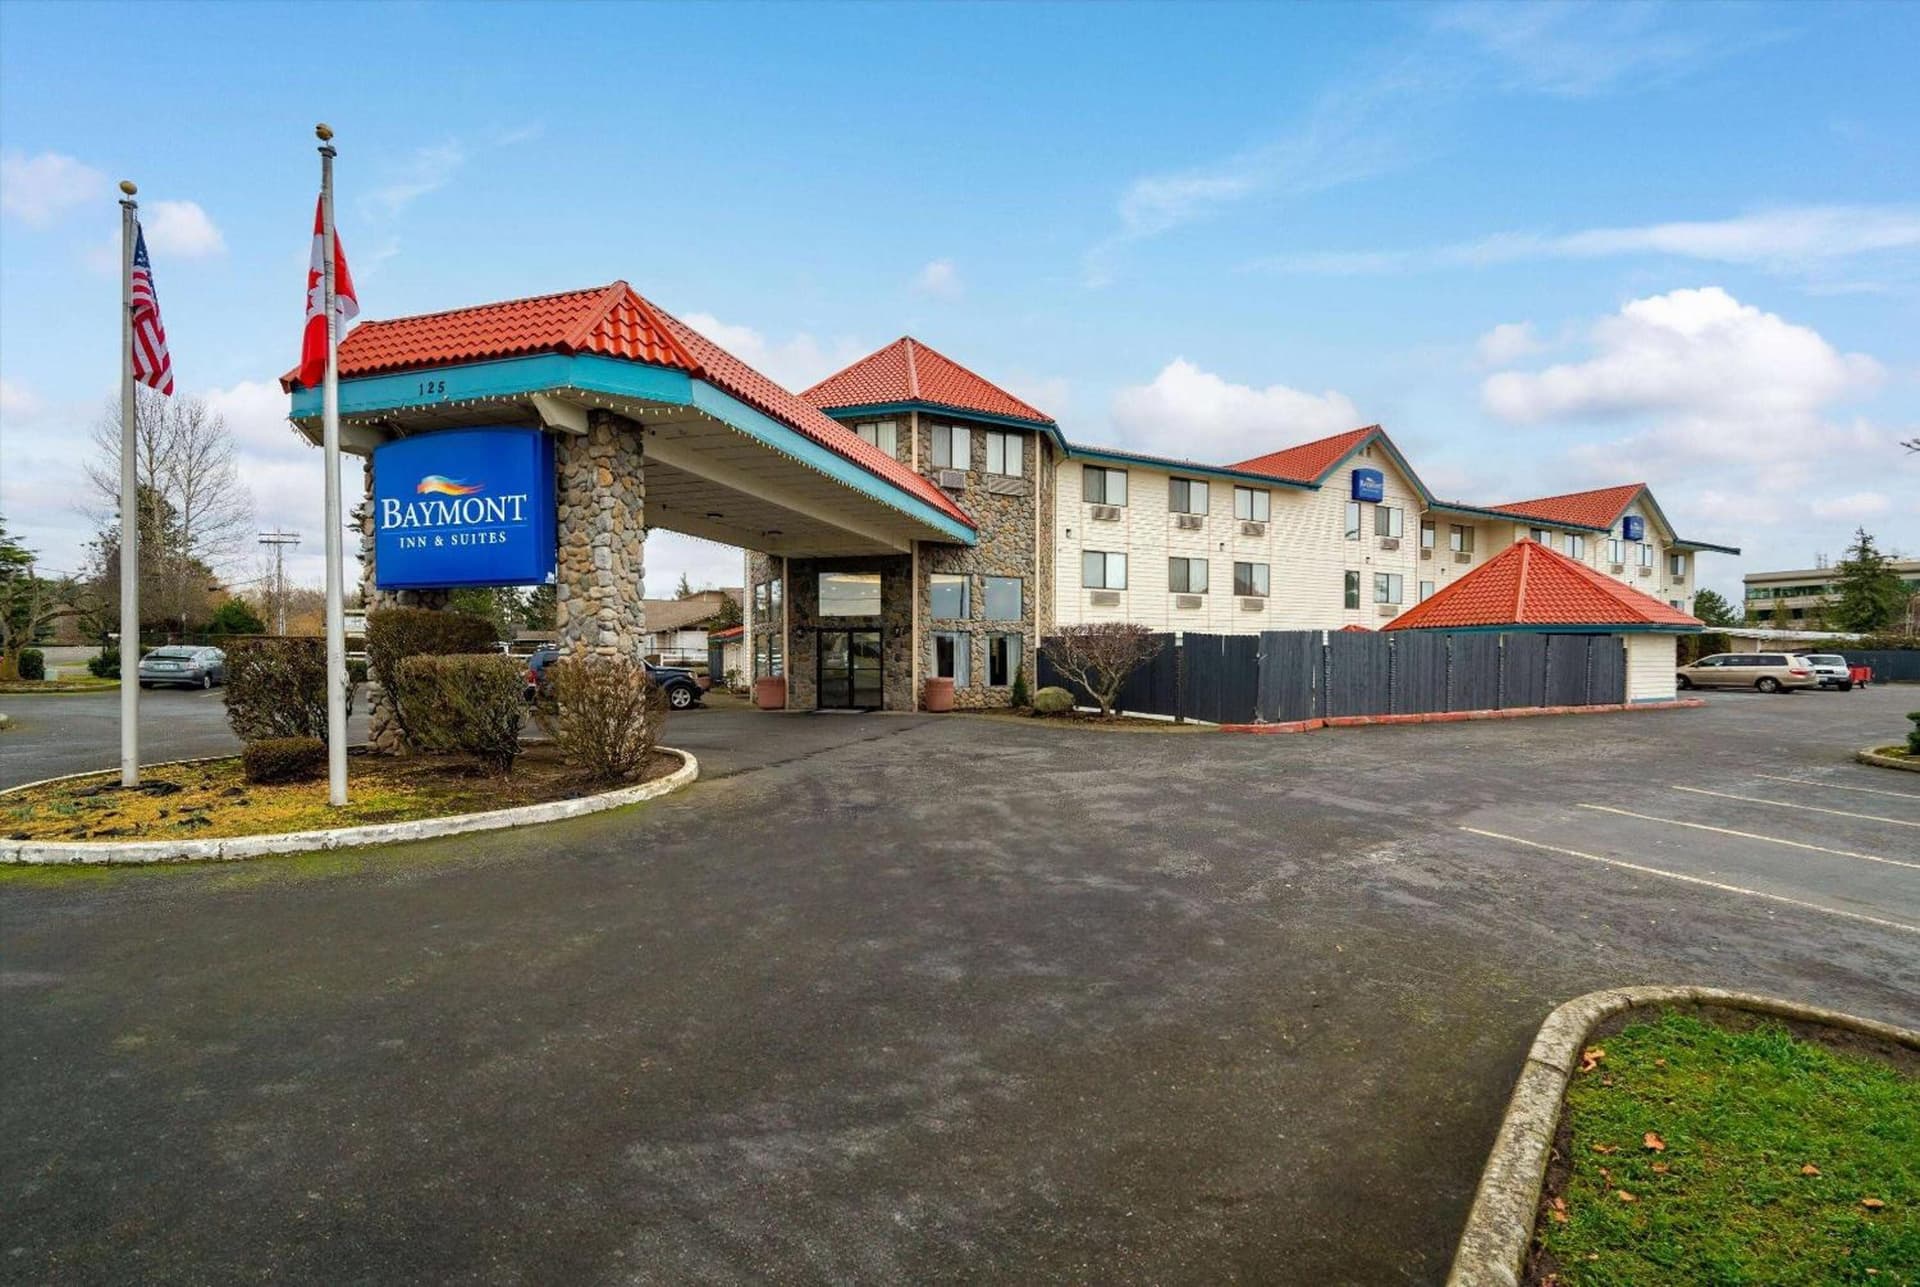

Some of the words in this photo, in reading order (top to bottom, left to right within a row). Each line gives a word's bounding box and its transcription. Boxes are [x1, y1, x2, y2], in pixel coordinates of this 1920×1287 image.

[419, 381, 446, 396] 125
[381, 494, 527, 529] BAYMONT
[400, 536, 427, 548] INN
[434, 535, 444, 547] &
[451, 531, 507, 545] SUITES
